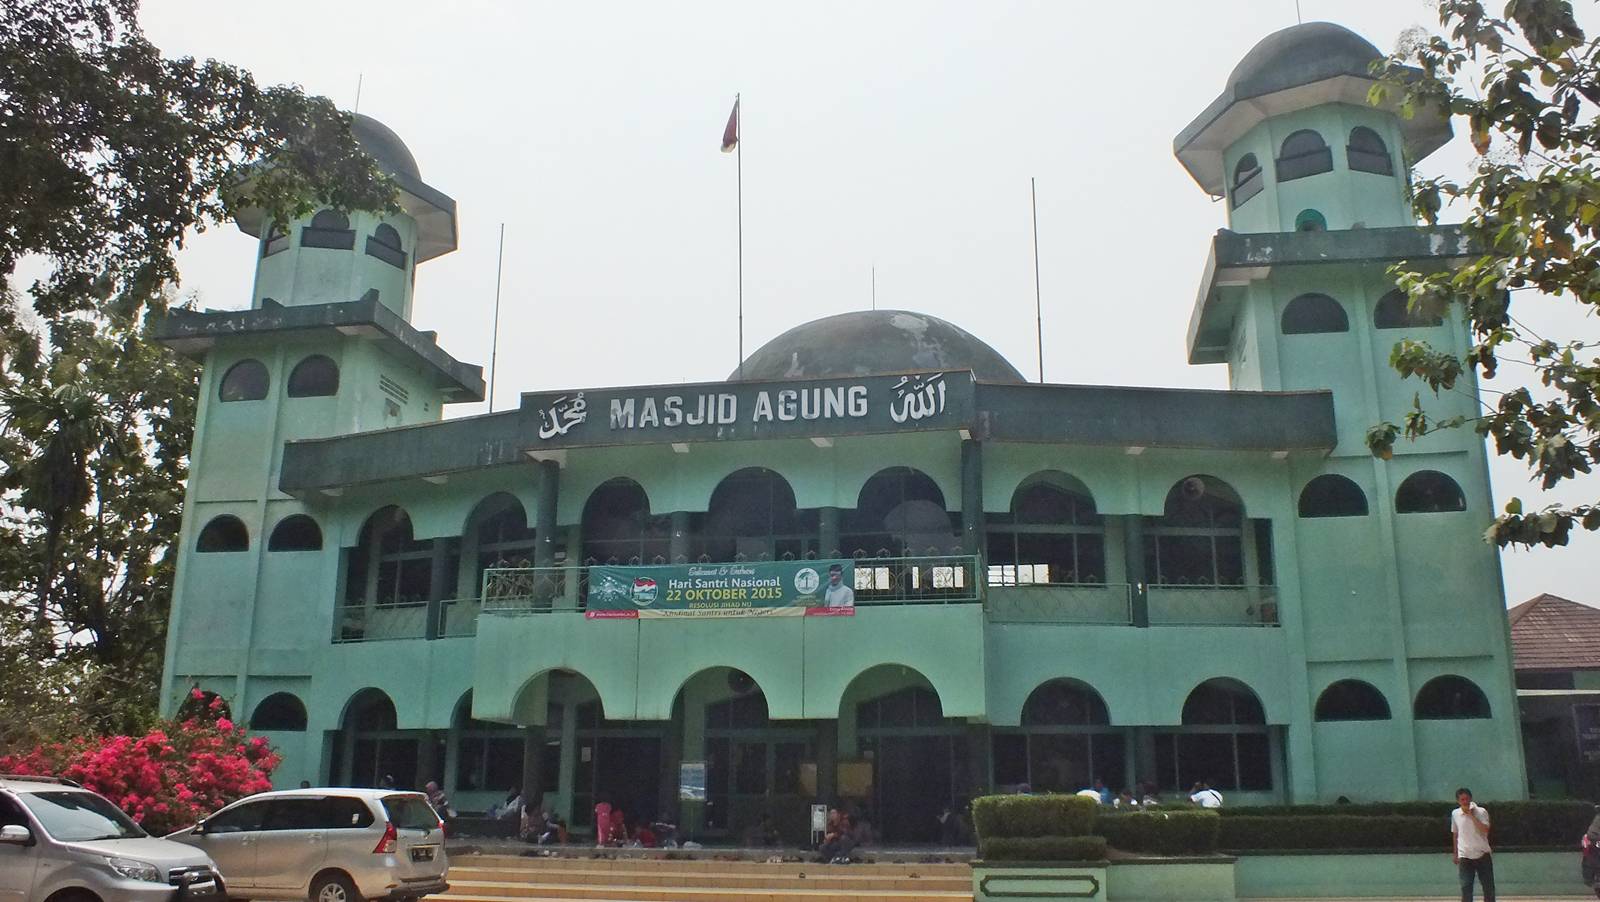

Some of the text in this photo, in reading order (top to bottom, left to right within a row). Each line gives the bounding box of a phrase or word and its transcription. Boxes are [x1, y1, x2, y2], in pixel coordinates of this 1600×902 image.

[610, 386, 868, 429] MASJID AGUNG
[669, 576, 781, 589] Hari Santri Nasional
[666, 588, 782, 601] 22 OKTOBER 2015
